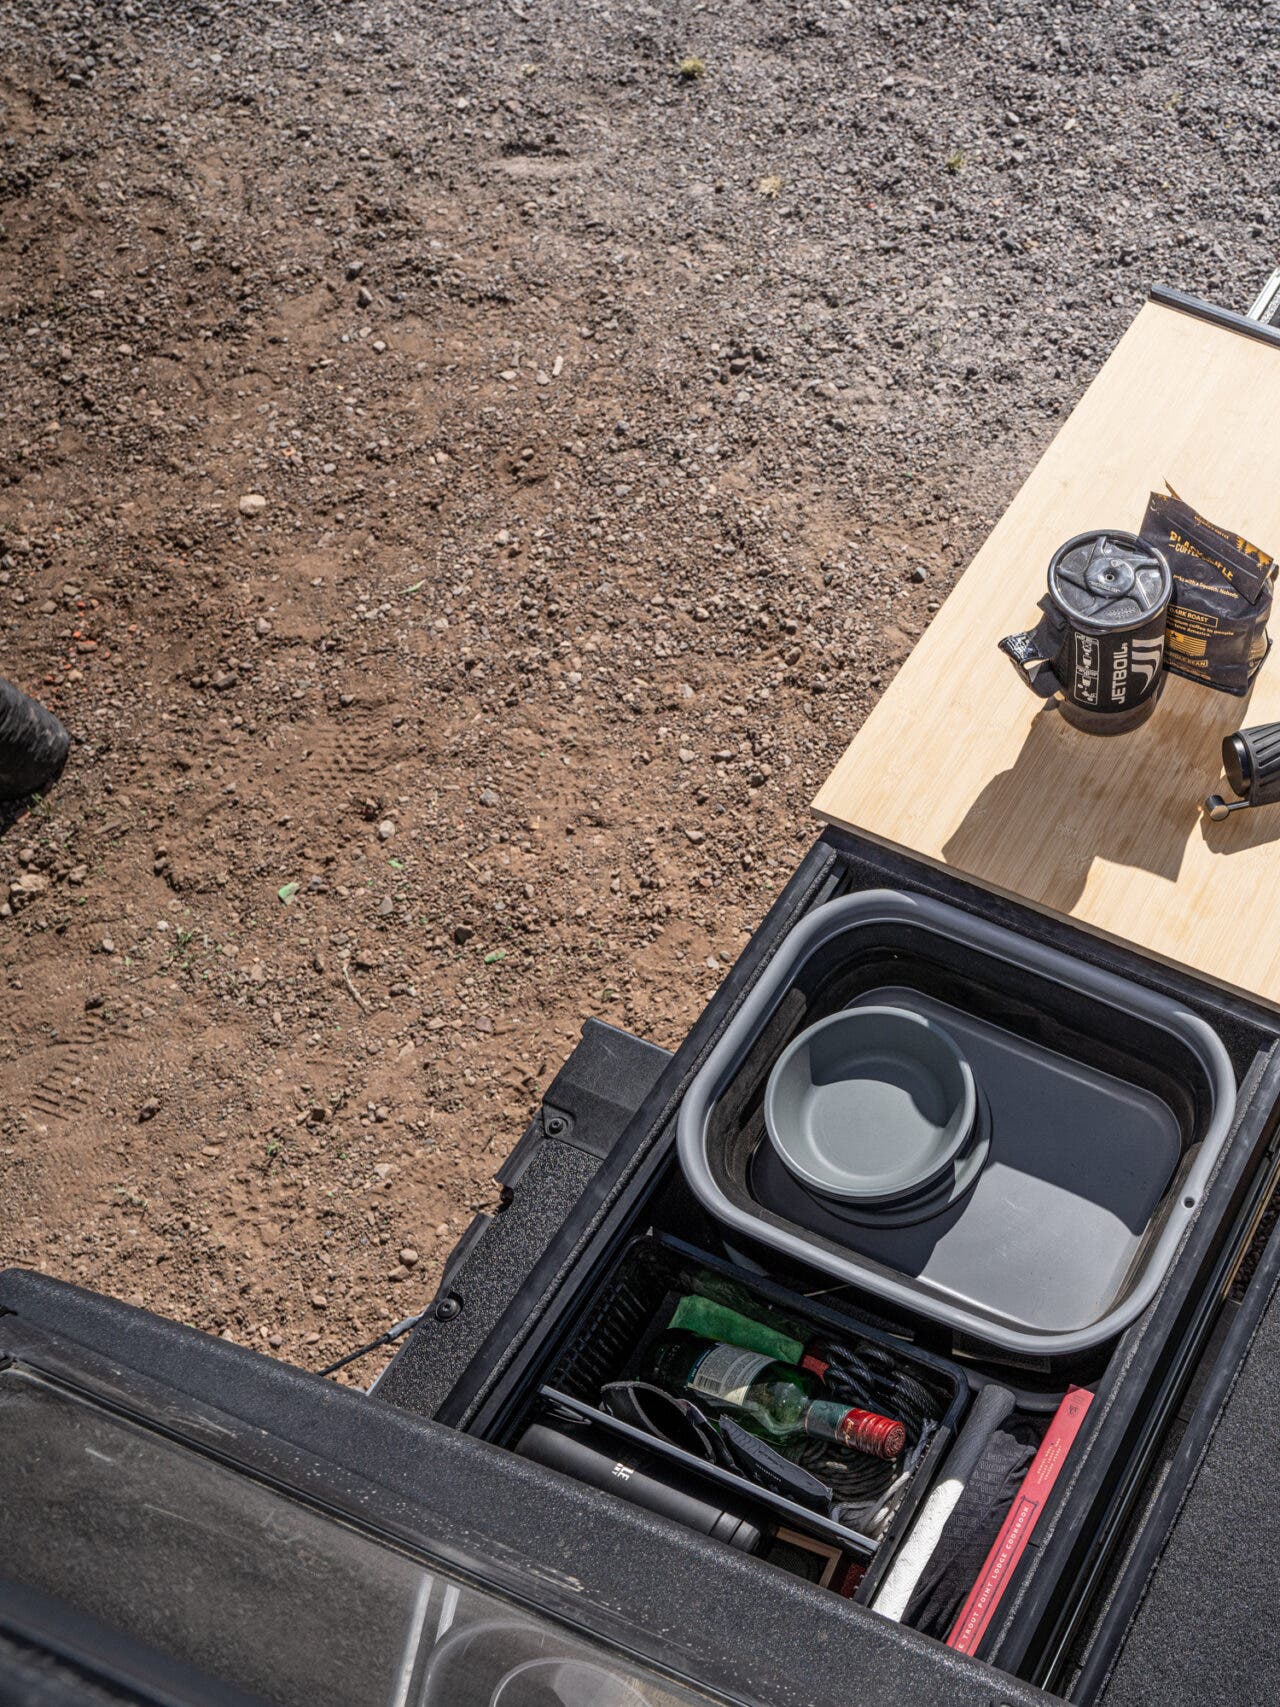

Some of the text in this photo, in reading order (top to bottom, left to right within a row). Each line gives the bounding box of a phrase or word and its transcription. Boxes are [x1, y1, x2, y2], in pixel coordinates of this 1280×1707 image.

[1187, 613, 1208, 623] ROAST
[1111, 647, 1127, 703] JETBOIL
[963, 1612, 979, 1639] TROUT
[978, 1582, 993, 1608] POINT
[991, 1553, 1007, 1578] LODGE
[1006, 1507, 1029, 1549] COOKBOOK
